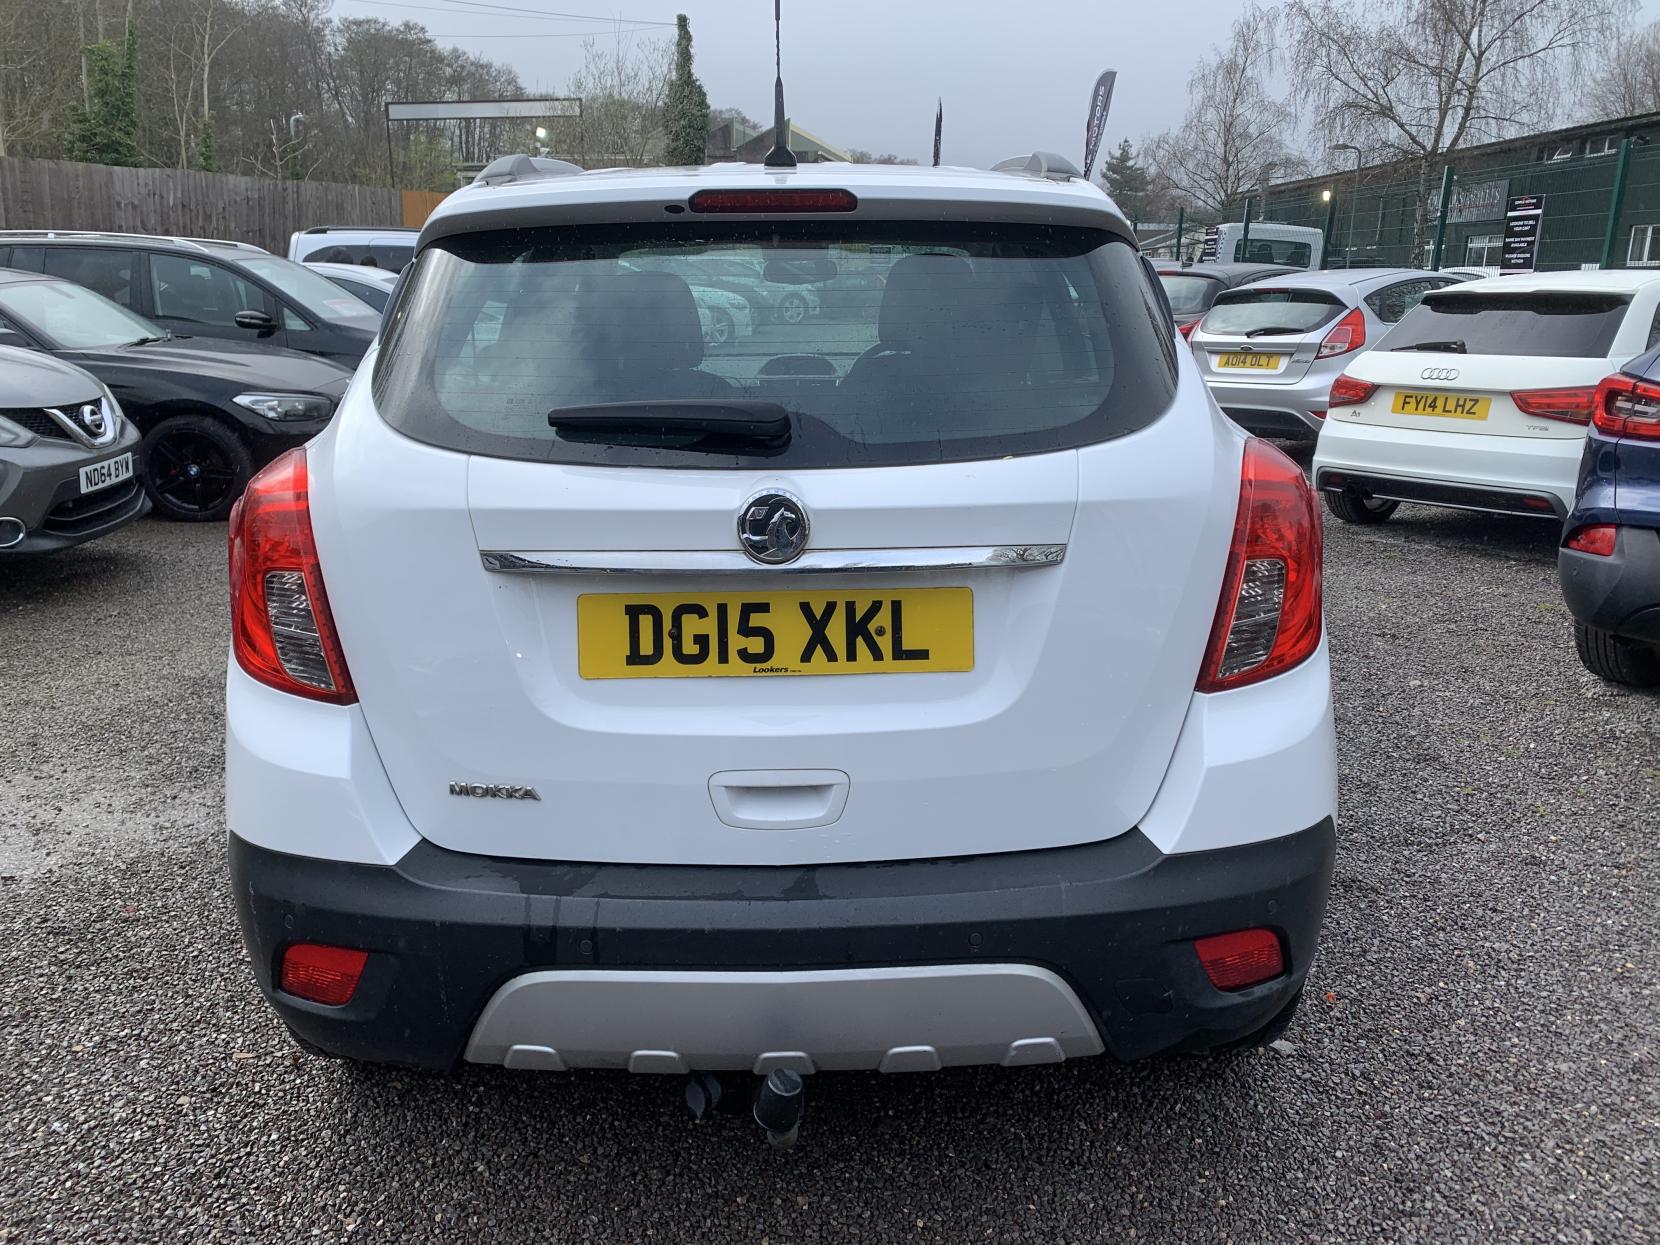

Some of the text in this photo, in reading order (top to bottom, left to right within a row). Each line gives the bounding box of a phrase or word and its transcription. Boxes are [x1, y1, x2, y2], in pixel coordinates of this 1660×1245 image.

[1090, 85, 1105, 149] MOTORS
[1401, 394, 1480, 415] FY14 LHZ
[85, 455, 130, 489] ND64 BYW
[624, 600, 930, 666] DG15 XKL
[449, 781, 542, 801] MOKKA
